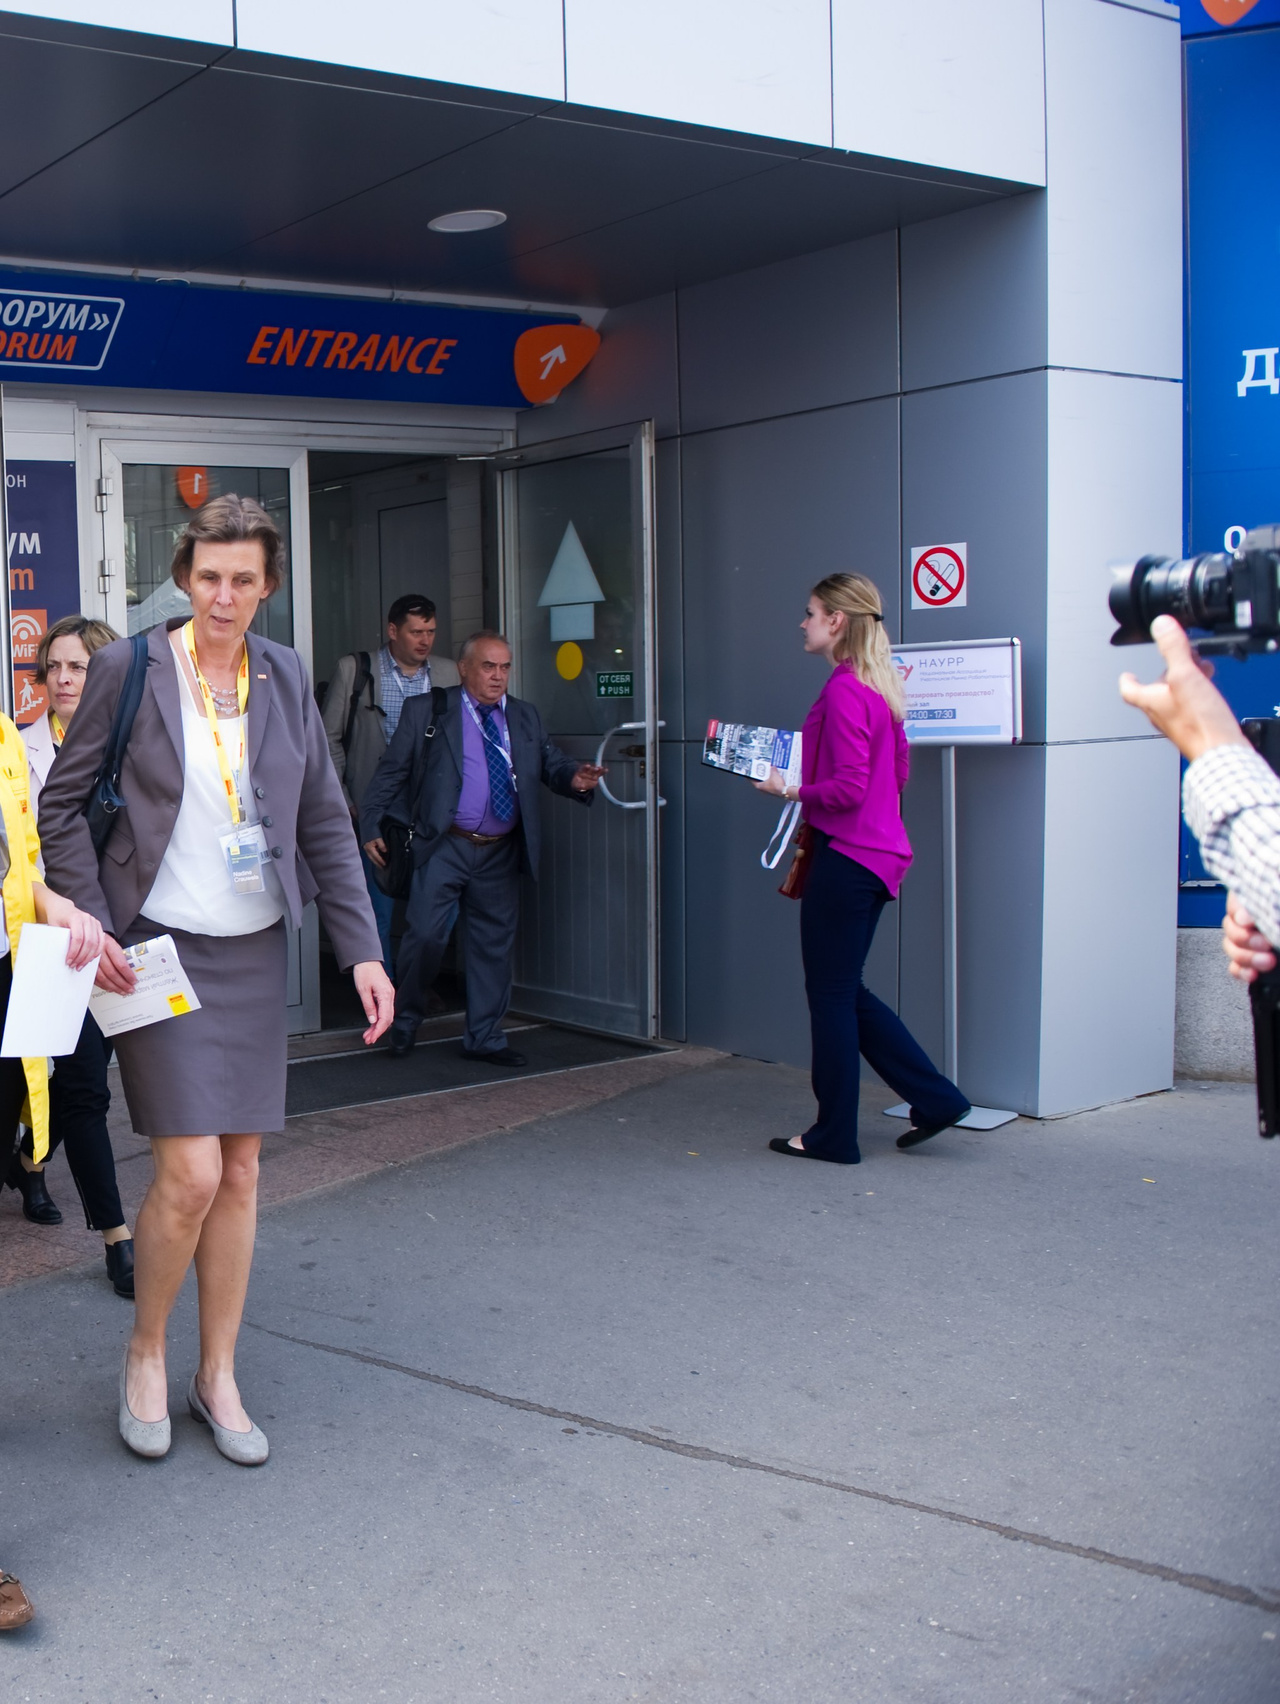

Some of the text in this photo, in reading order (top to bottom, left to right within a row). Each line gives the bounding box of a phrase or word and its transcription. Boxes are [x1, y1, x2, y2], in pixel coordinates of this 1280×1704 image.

[247, 325, 458, 376] ENTRANCE
[1237, 347, 1280, 397] Д
[919, 657, 964, 668] НАУРР
[599, 674, 631, 684] ОТ СЕБЯ
[608, 686, 630, 695] PUSH
[934, 710, 953, 719] 17:30
